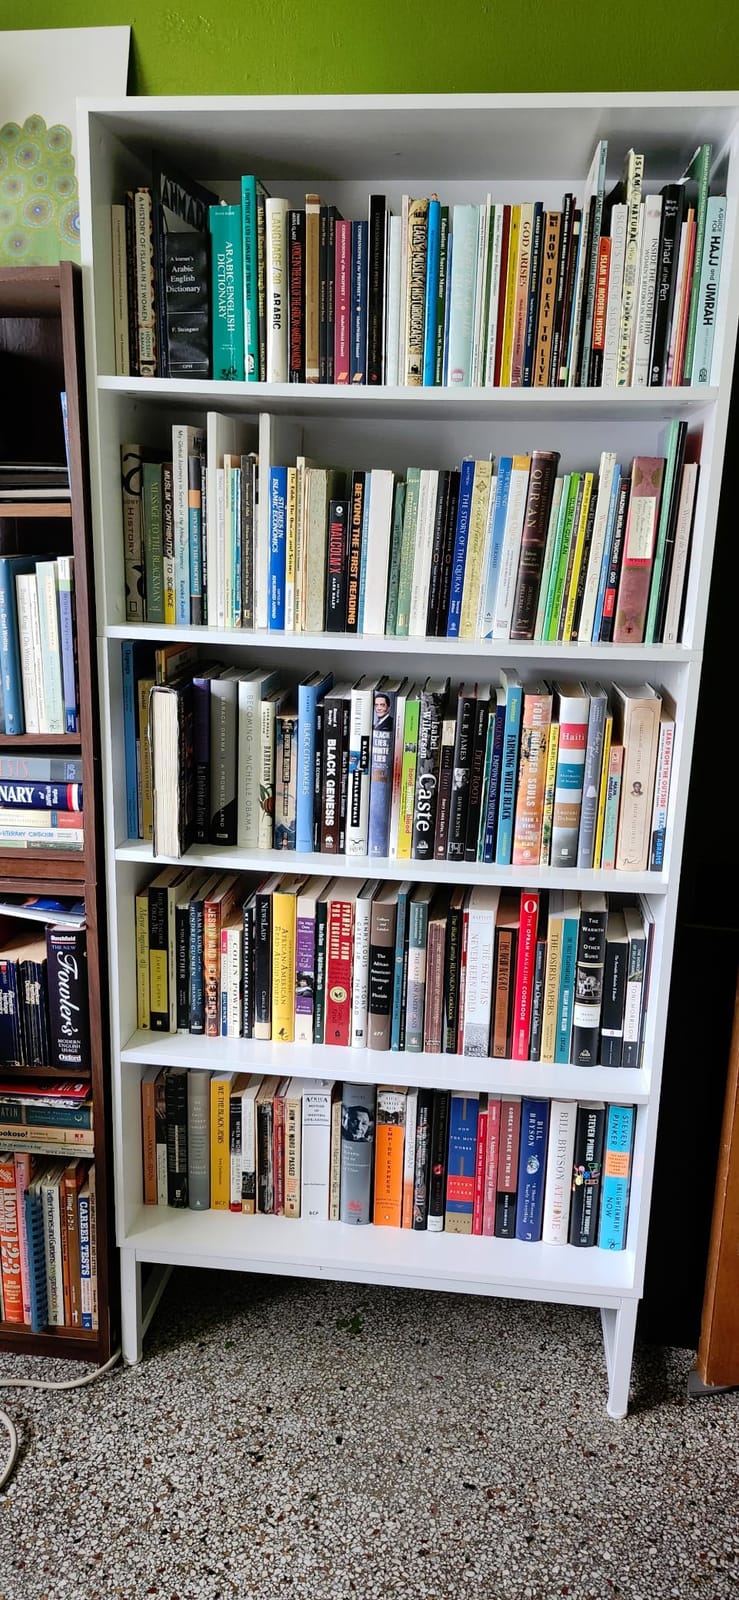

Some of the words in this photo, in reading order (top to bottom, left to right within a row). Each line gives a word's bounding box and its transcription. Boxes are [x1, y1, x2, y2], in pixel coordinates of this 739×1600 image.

[413, 225, 424, 248] EARLY
[629, 204, 638, 243] NATURAL
[140, 238, 146, 248] OF
[546, 234, 556, 260] HOW
[663, 238, 673, 264] Jihad
[709, 236, 721, 266] HAJJ
[411, 252, 424, 284] MUSLIM
[519, 249, 529, 287] ARISES
[546, 268, 552, 285] TO
[599, 255, 607, 275] ISLAM
[217, 254, 226, 320] DICTIONARY
[226, 242, 235, 331] ARABIC-ENGLISH
[660, 284, 669, 300] Pen
[596, 288, 605, 315] MODERN
[645, 286, 655, 317] GENDER
[703, 283, 716, 325] UMRAH
[409, 288, 423, 350] HISTORIOGRAPHY
[541, 326, 548, 341] TO
[595, 318, 603, 346] HISTORY
[643, 321, 653, 345] JIHAD
[150, 482, 159, 521] MESSAGE
[353, 483, 362, 525] BEYOND
[527, 470, 543, 528] QUR'AN
[618, 491, 626, 514] AMAZING
[352, 528, 360, 547] THE
[459, 511, 467, 535] STORY
[330, 522, 343, 566] MALCOLM
[456, 549, 465, 563] THE
[612, 539, 621, 563] TOUCHED
[152, 555, 160, 602] BLACKMAN
[167, 563, 173, 573] TO
[350, 550, 359, 578] FIRST
[454, 564, 463, 592] QUR'AN
[348, 581, 357, 624] READING
[532, 702, 542, 726] FOUR
[420, 710, 430, 759] Wilkerson
[429, 721, 440, 750] Isabel
[326, 739, 336, 776] BLACK
[474, 750, 482, 772] DEEP
[506, 734, 516, 768] FARMING
[528, 732, 540, 773] HUNDRED
[302, 748, 310, 794] CITYMAKERS
[490, 755, 500, 798] EMPOWERING
[504, 771, 513, 795] WHILE
[326, 780, 335, 826] GENESIS
[415, 774, 436, 831] Caste
[470, 776, 480, 805] ROOTS
[527, 778, 537, 806] SOULS
[660, 781, 668, 807] OUTSIDE
[486, 800, 495, 829] YOURSELF
[502, 798, 511, 820] BLACK
[332, 904, 340, 917] THE
[342, 905, 351, 936] STAMPED
[331, 922, 339, 959] BEGINNING
[341, 942, 350, 960] FROM
[447, 943, 456, 961] Family
[500, 941, 510, 953] THE
[498, 967, 509, 990] NEGRO
[57, 951, 80, 1036] Fowler's
[520, 986, 528, 1021] COOKBOOK
[547, 984, 556, 1016] PAPERS
[59, 1054, 81, 1062] Oxford
[218, 1086, 224, 1096] WE
[528, 1113, 536, 1146] BRYSON
[559, 1112, 568, 1135] BILL
[588, 1115, 596, 1137] STEVEN
[620, 1115, 629, 1146] STEVEN
[556, 1139, 565, 1180] BRYSON
[586, 1139, 594, 1161] PINKER
[554, 1184, 562, 1198] AT
[5, 1188, 17, 1233] HOME
[80, 1201, 88, 1242] CAREER
[613, 1184, 623, 1232] ENLIGHTENMENT
[1, 1234, 20, 1274] 1-2-3
[81, 1245, 90, 1276] TESTS
